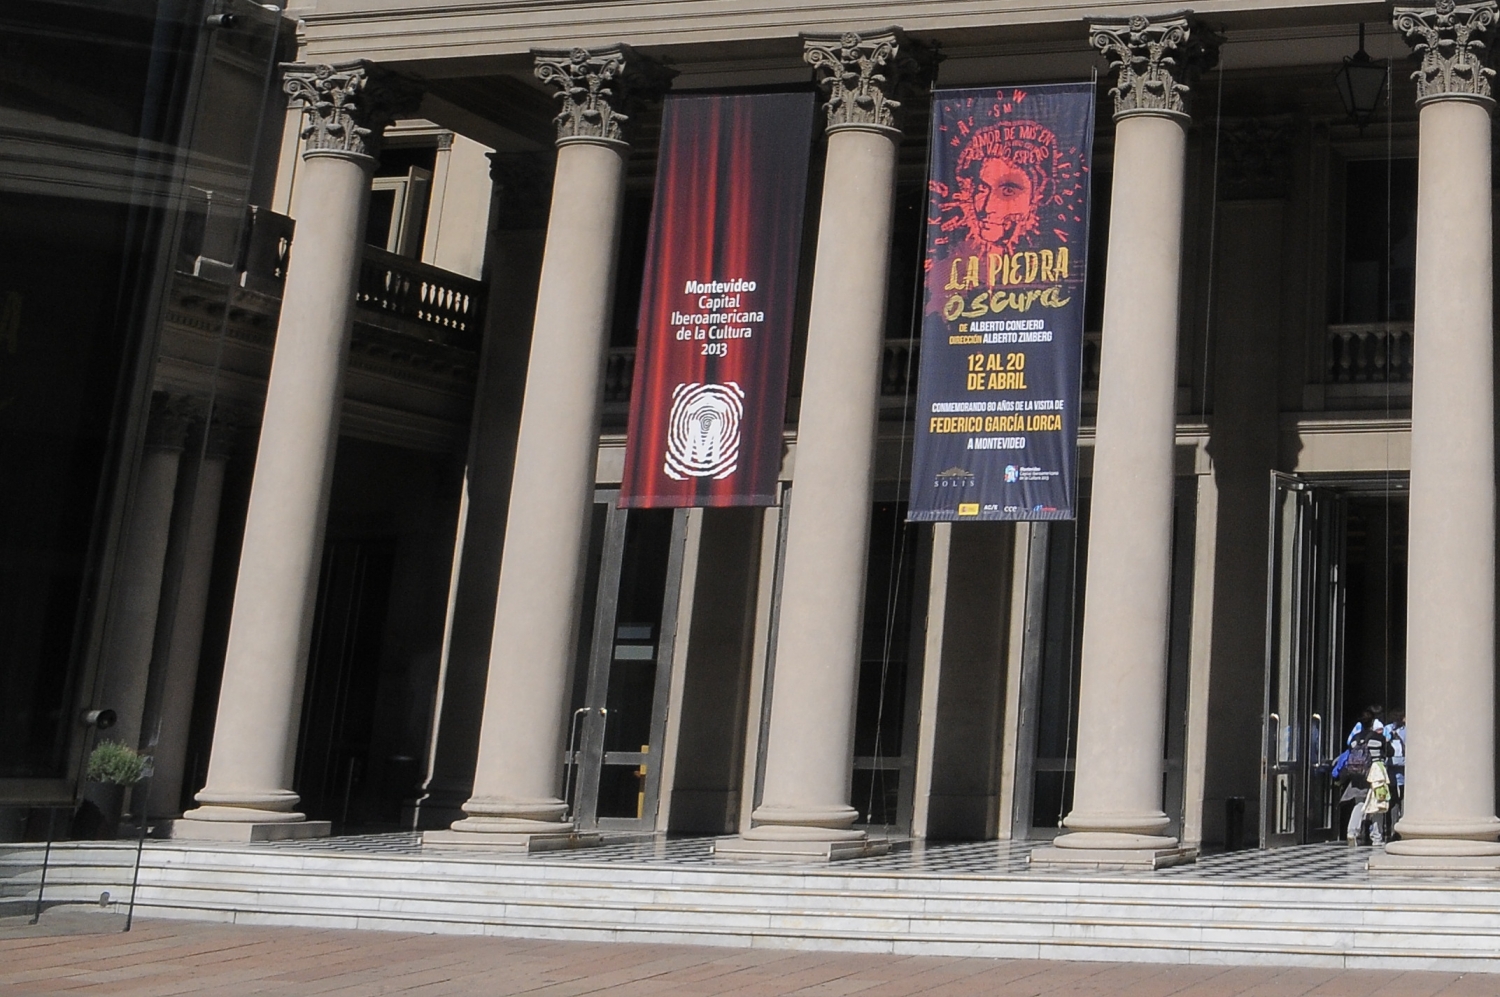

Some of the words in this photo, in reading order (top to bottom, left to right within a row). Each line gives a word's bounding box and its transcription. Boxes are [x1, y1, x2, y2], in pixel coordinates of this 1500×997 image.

[944, 256, 979, 291] LA
[989, 247, 1069, 286] PIEDRA
[685, 279, 756, 294] Montevideo
[698, 294, 740, 311] Capital
[671, 310, 764, 326] Iberoamericana
[970, 321, 1004, 332] ALBERTO
[1006, 319, 1044, 331] CONEJERO
[676, 327, 692, 341] de
[694, 326, 705, 340] la
[708, 325, 752, 339] Cultura
[983, 332, 1017, 344] ALBERTO
[1018, 331, 1053, 343] ZIMBERG
[701, 343, 728, 357] 2013
[968, 354, 985, 372] 12
[986, 353, 1004, 371] AL
[1007, 353, 1025, 370] 20
[967, 373, 985, 390] DE
[987, 372, 1027, 390] ABRIL
[932, 402, 986, 412] CONMEMORANDO
[997, 399, 1014, 412] AÑOS
[1015, 401, 1024, 411] DE
[1024, 401, 1033, 410] LA
[1034, 400, 1054, 410] VISITA
[1054, 399, 1064, 410] DE
[929, 416, 983, 433] FEDERICO
[984, 413, 1024, 432] GARCÍA
[1026, 414, 1061, 431] LORCA
[967, 438, 974, 450] A
[975, 437, 1026, 450] MONTEVIDEO
